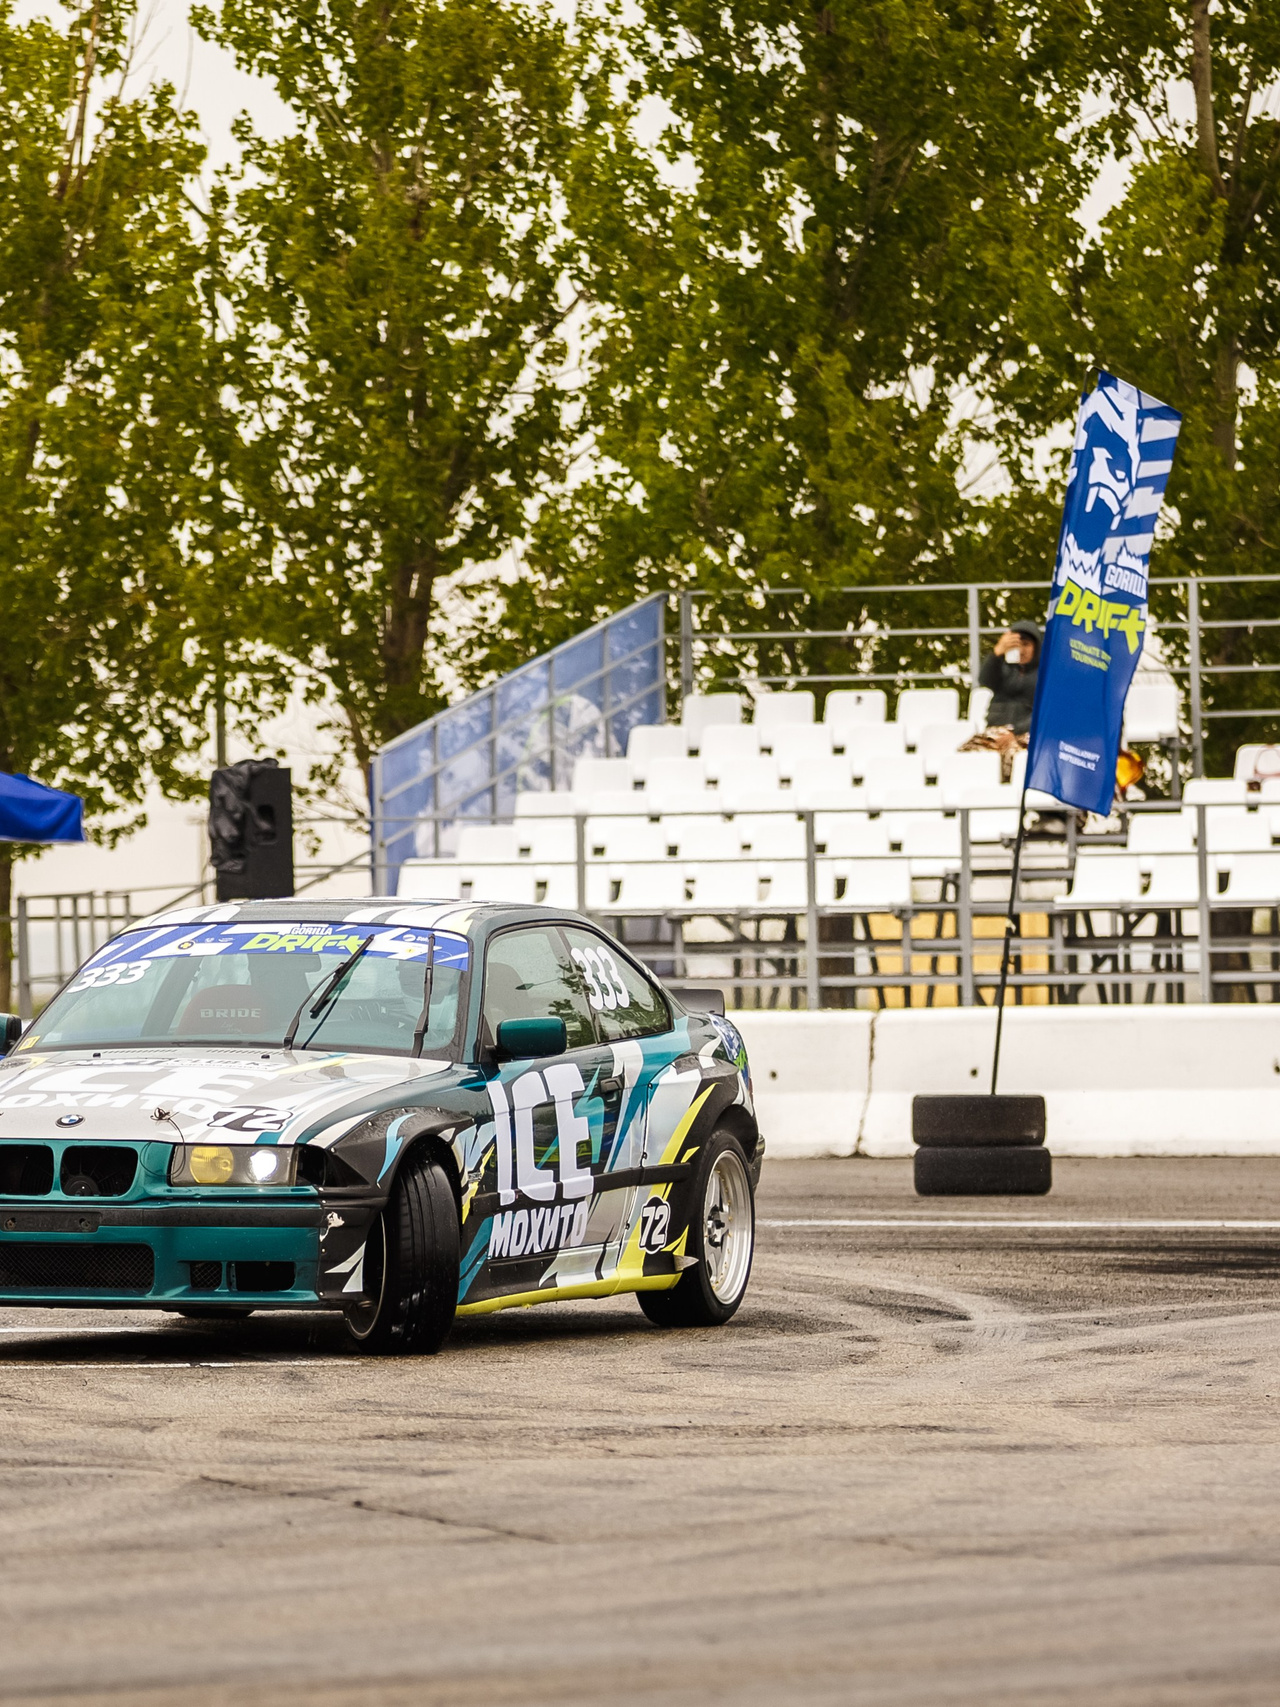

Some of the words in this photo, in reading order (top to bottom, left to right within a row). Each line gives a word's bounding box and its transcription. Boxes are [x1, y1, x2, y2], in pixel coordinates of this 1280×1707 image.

[1104, 564, 1147, 600] GORILLA
[290, 927, 333, 936] GORILLA
[66, 960, 151, 993] 333
[570, 946, 630, 1010] 333
[200, 1008, 261, 1019] BRIDE
[209, 1107, 293, 1132] 72
[486, 1063, 594, 1206] ICE
[640, 1201, 670, 1250] 72
